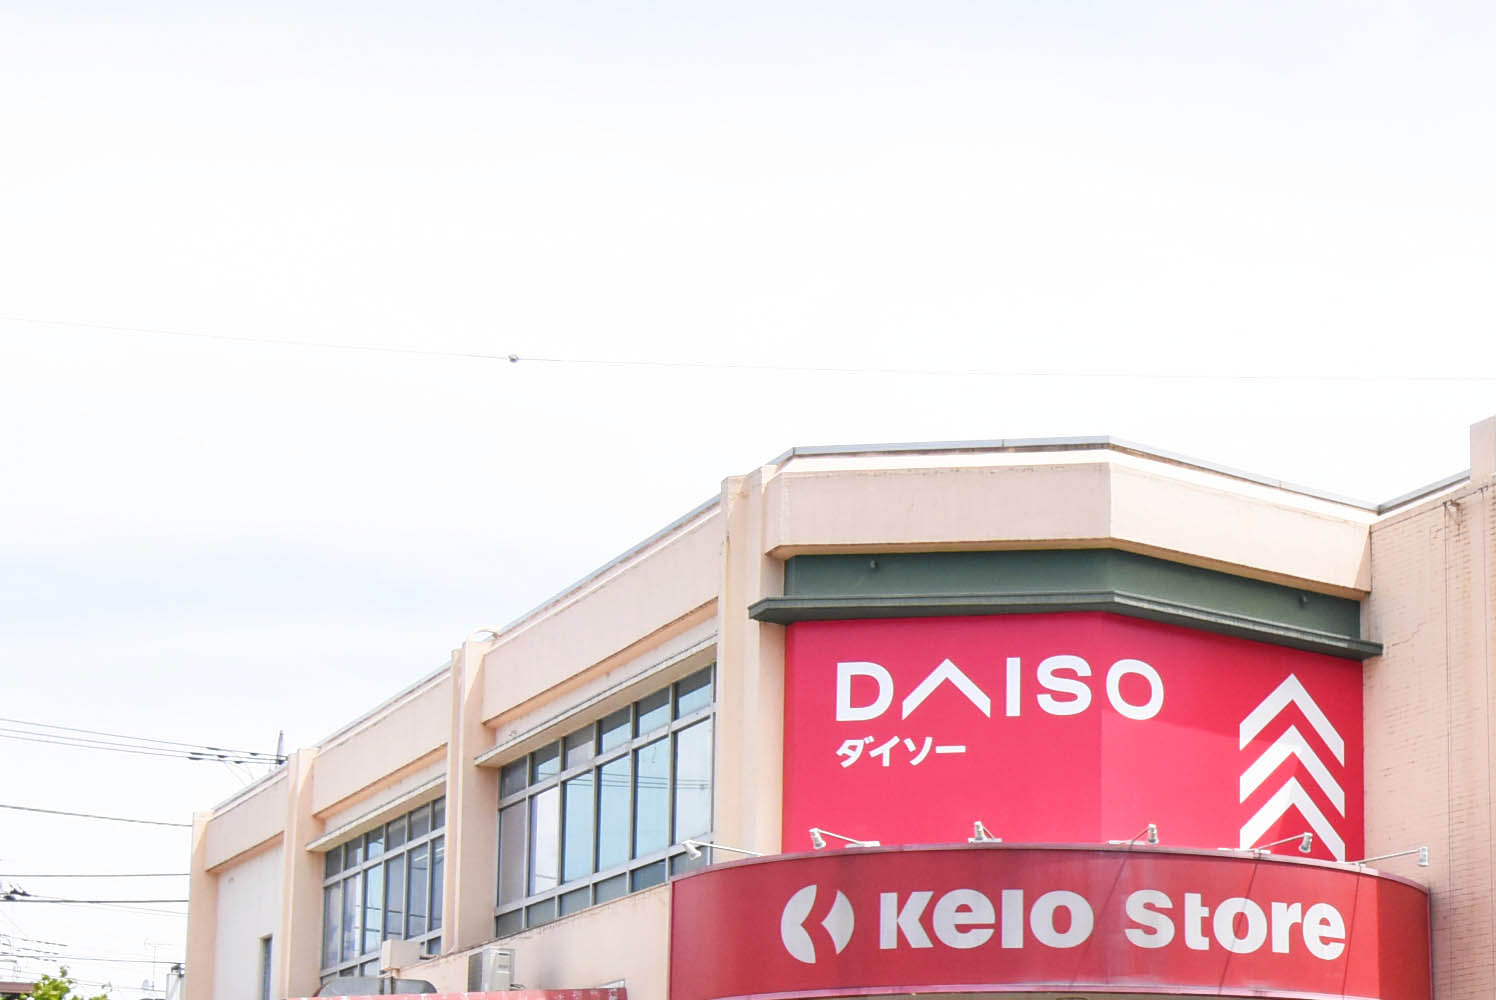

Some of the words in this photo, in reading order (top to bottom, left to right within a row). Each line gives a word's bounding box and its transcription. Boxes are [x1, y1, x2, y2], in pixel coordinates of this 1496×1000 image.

[835, 654, 1166, 722] DAISO
[835, 735, 967, 768] ダイソー
[1124, 889, 1346, 961] Store
